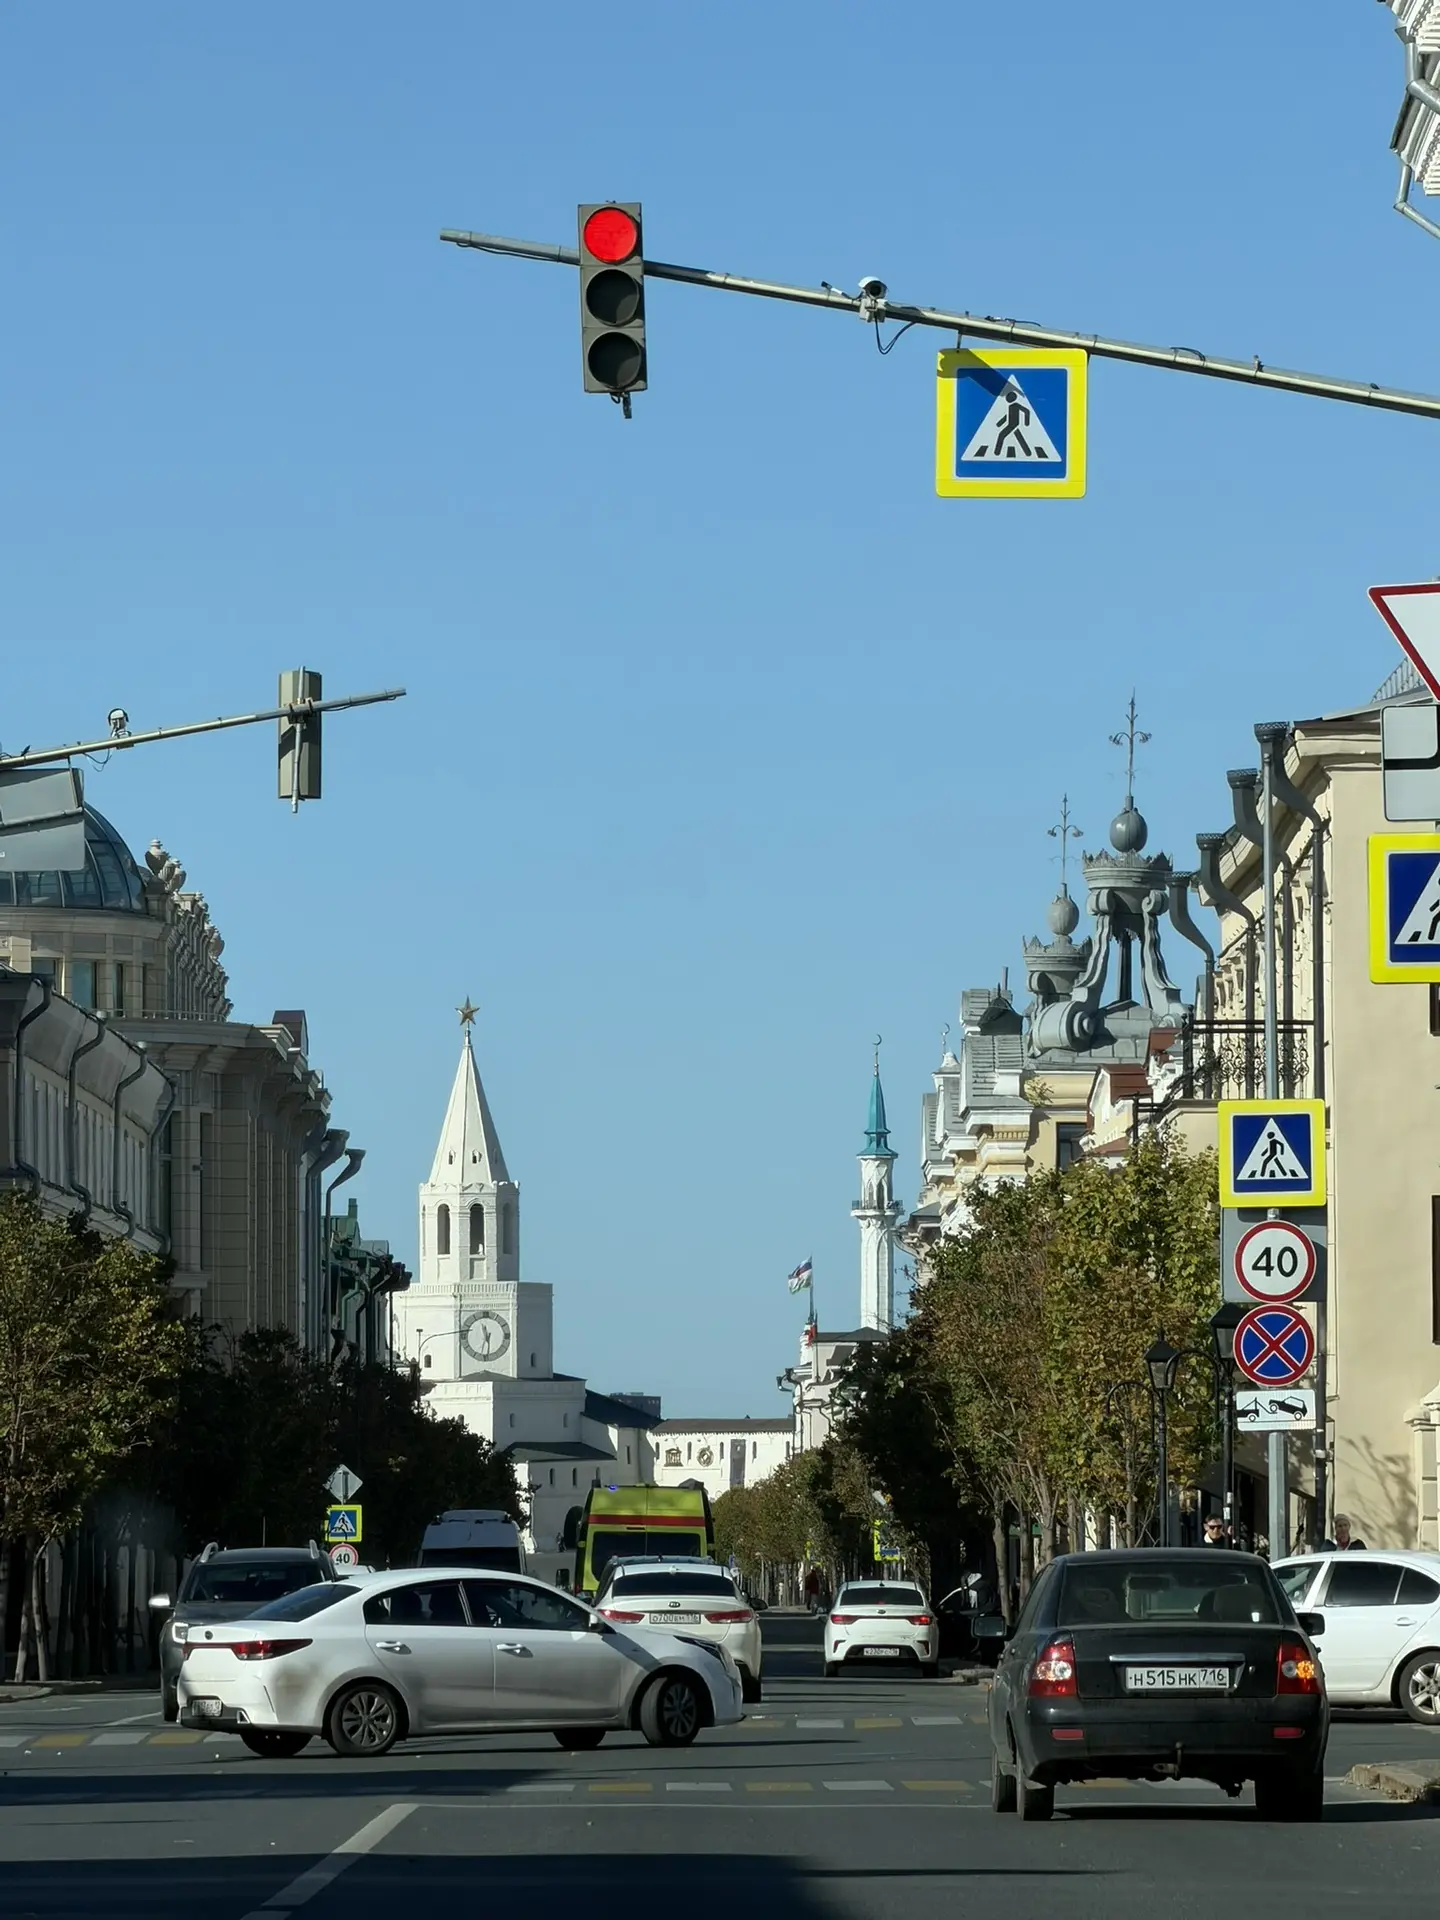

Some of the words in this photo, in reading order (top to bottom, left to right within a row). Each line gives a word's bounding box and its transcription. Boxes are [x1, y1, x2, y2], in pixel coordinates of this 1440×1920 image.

[1251, 1246, 1298, 1278] 40
[335, 1553, 350, 1564] 40
[1200, 1669, 1225, 1682] 716
